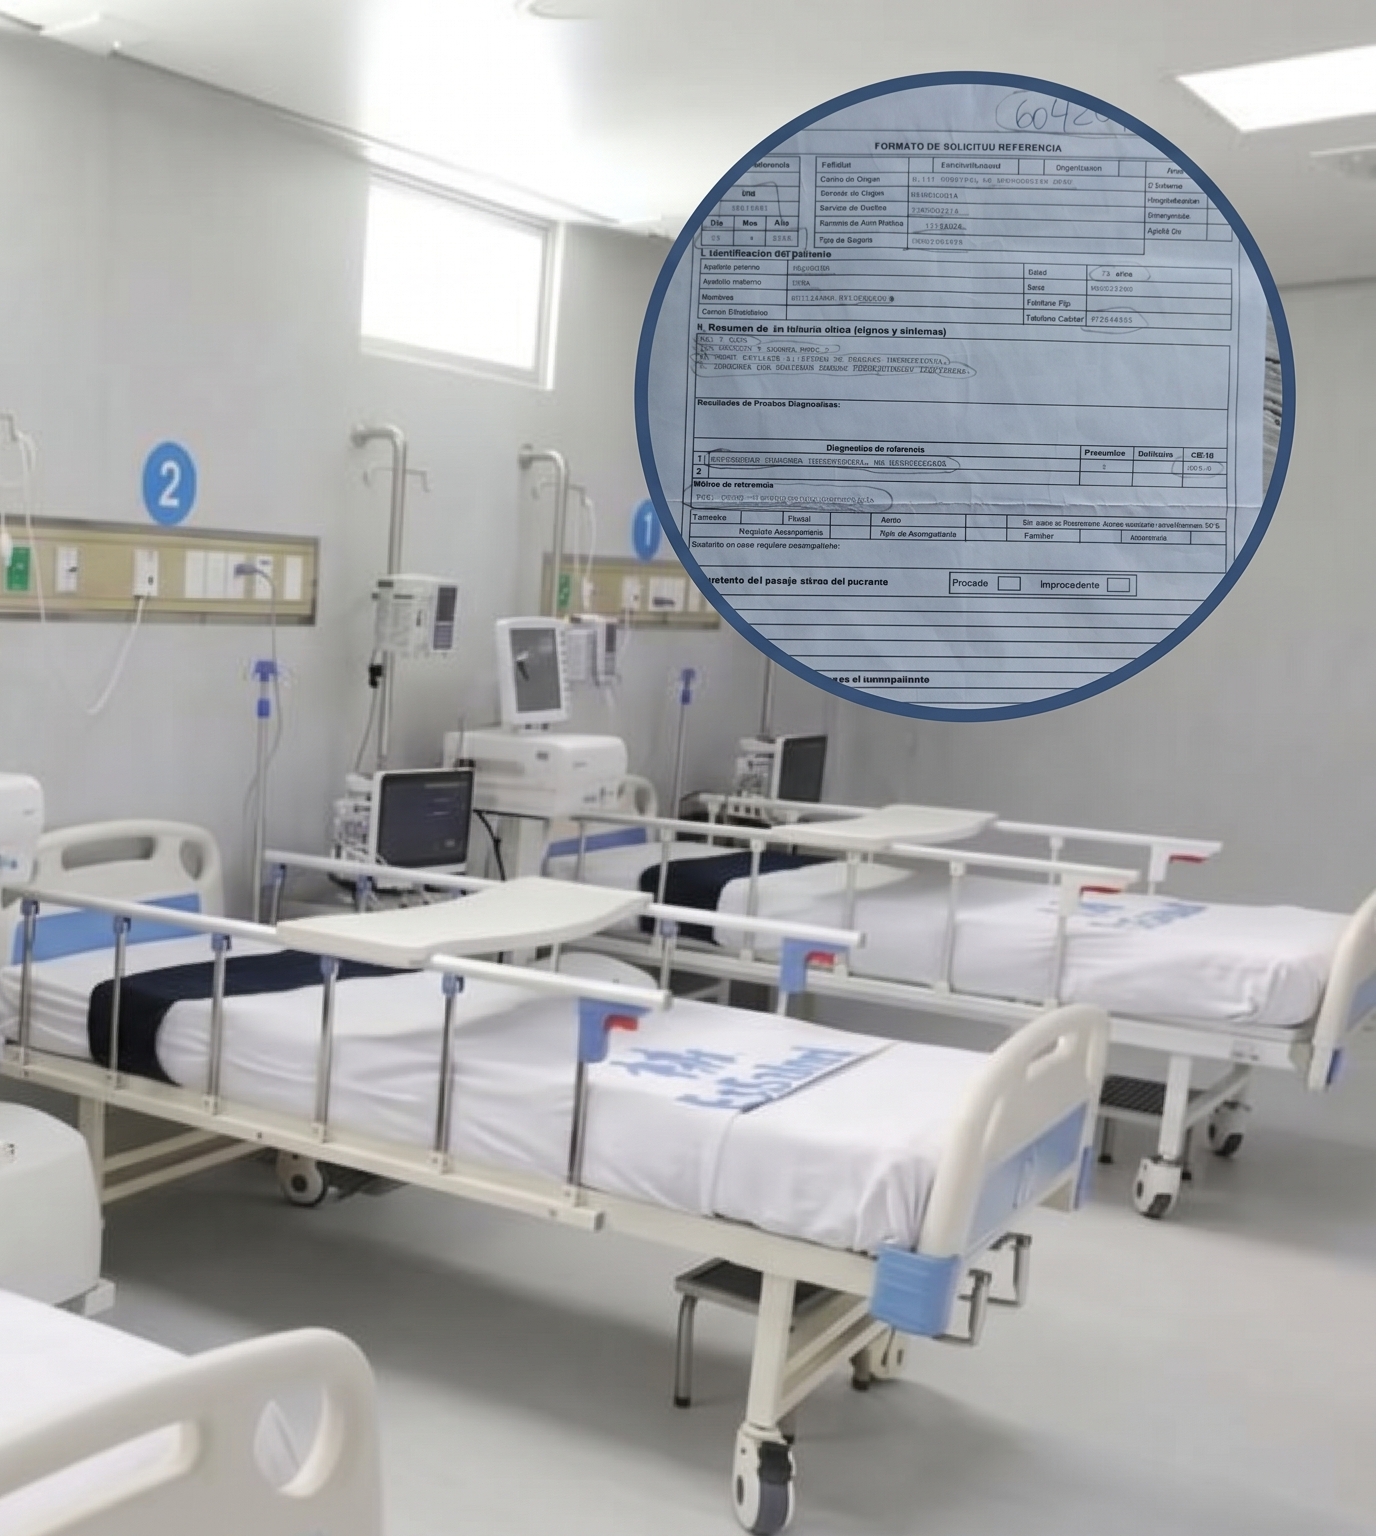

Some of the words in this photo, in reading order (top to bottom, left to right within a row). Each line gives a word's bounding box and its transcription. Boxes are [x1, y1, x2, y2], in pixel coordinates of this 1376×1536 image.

[874, 142, 924, 151] FORMATO
[926, 142, 941, 151] DE
[998, 143, 1062, 153] REFERENCIA
[755, 323, 769, 333] de
[741, 399, 752, 407] de
[874, 445, 885, 454] de
[159, 461, 181, 506] 2
[722, 482, 733, 490] de
[644, 512, 652, 546] 1
[897, 530, 908, 538] de
[747, 576, 763, 585] del
[765, 576, 798, 587] pasaje
[831, 577, 845, 586] del
[952, 579, 989, 588] Procade
[1040, 580, 1100, 591] Improcedente
[852, 675, 861, 683] el
